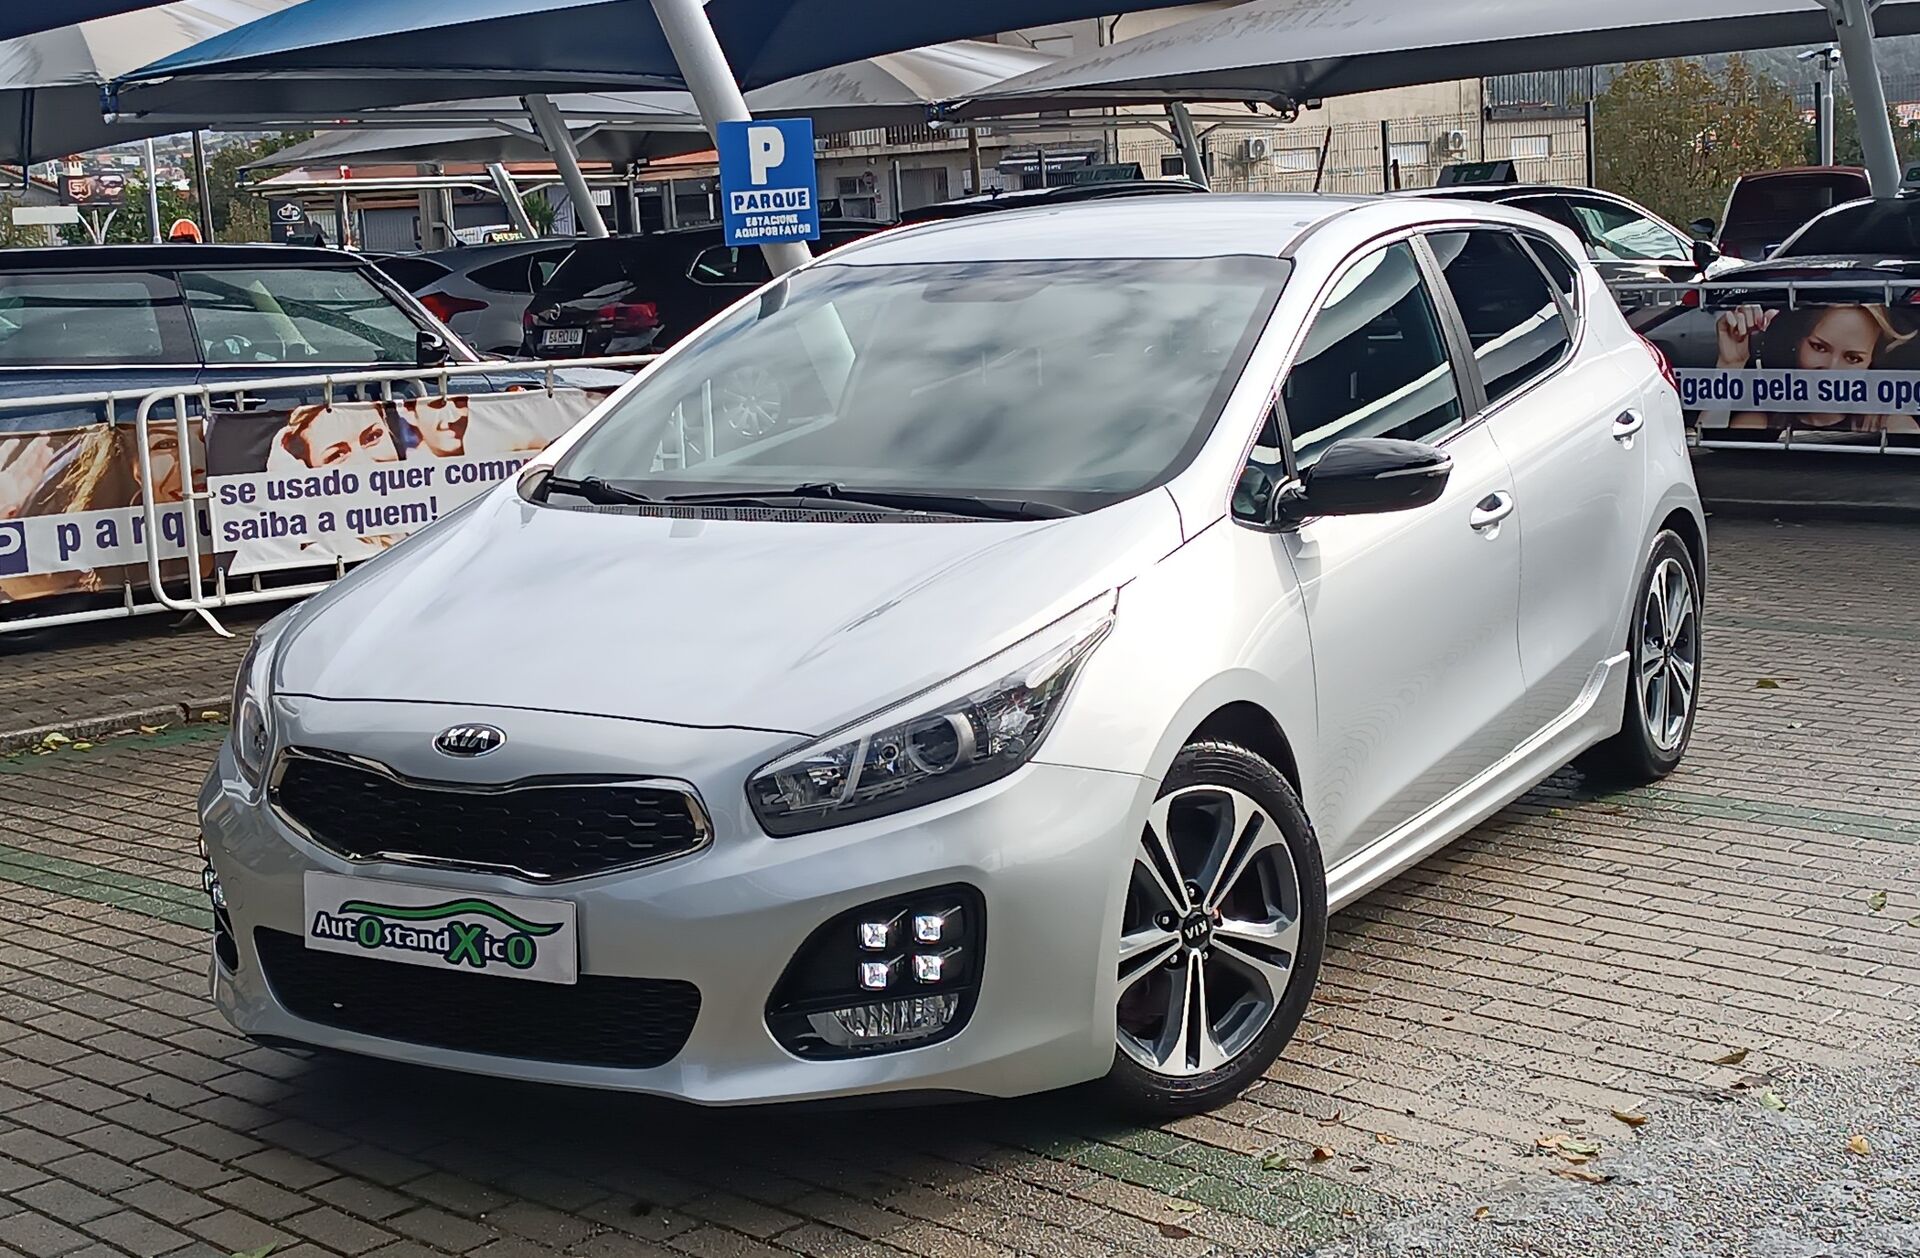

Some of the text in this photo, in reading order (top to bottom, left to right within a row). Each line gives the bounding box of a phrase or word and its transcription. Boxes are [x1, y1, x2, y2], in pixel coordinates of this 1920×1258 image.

[747, 126, 785, 185] P
[733, 190, 807, 212] PARQUE
[745, 214, 798, 227] ESTACIONE
[779, 223, 811, 236] FAVOR
[1753, 373, 1808, 406] pela
[1818, 379, 1867, 402] sua
[220, 481, 256, 505] se
[267, 469, 359, 501] usado
[369, 466, 435, 496] quer
[223, 496, 439, 543] saiba a quem!
[442, 728, 490, 750] KIA
[1184, 920, 1208, 939] KIA
